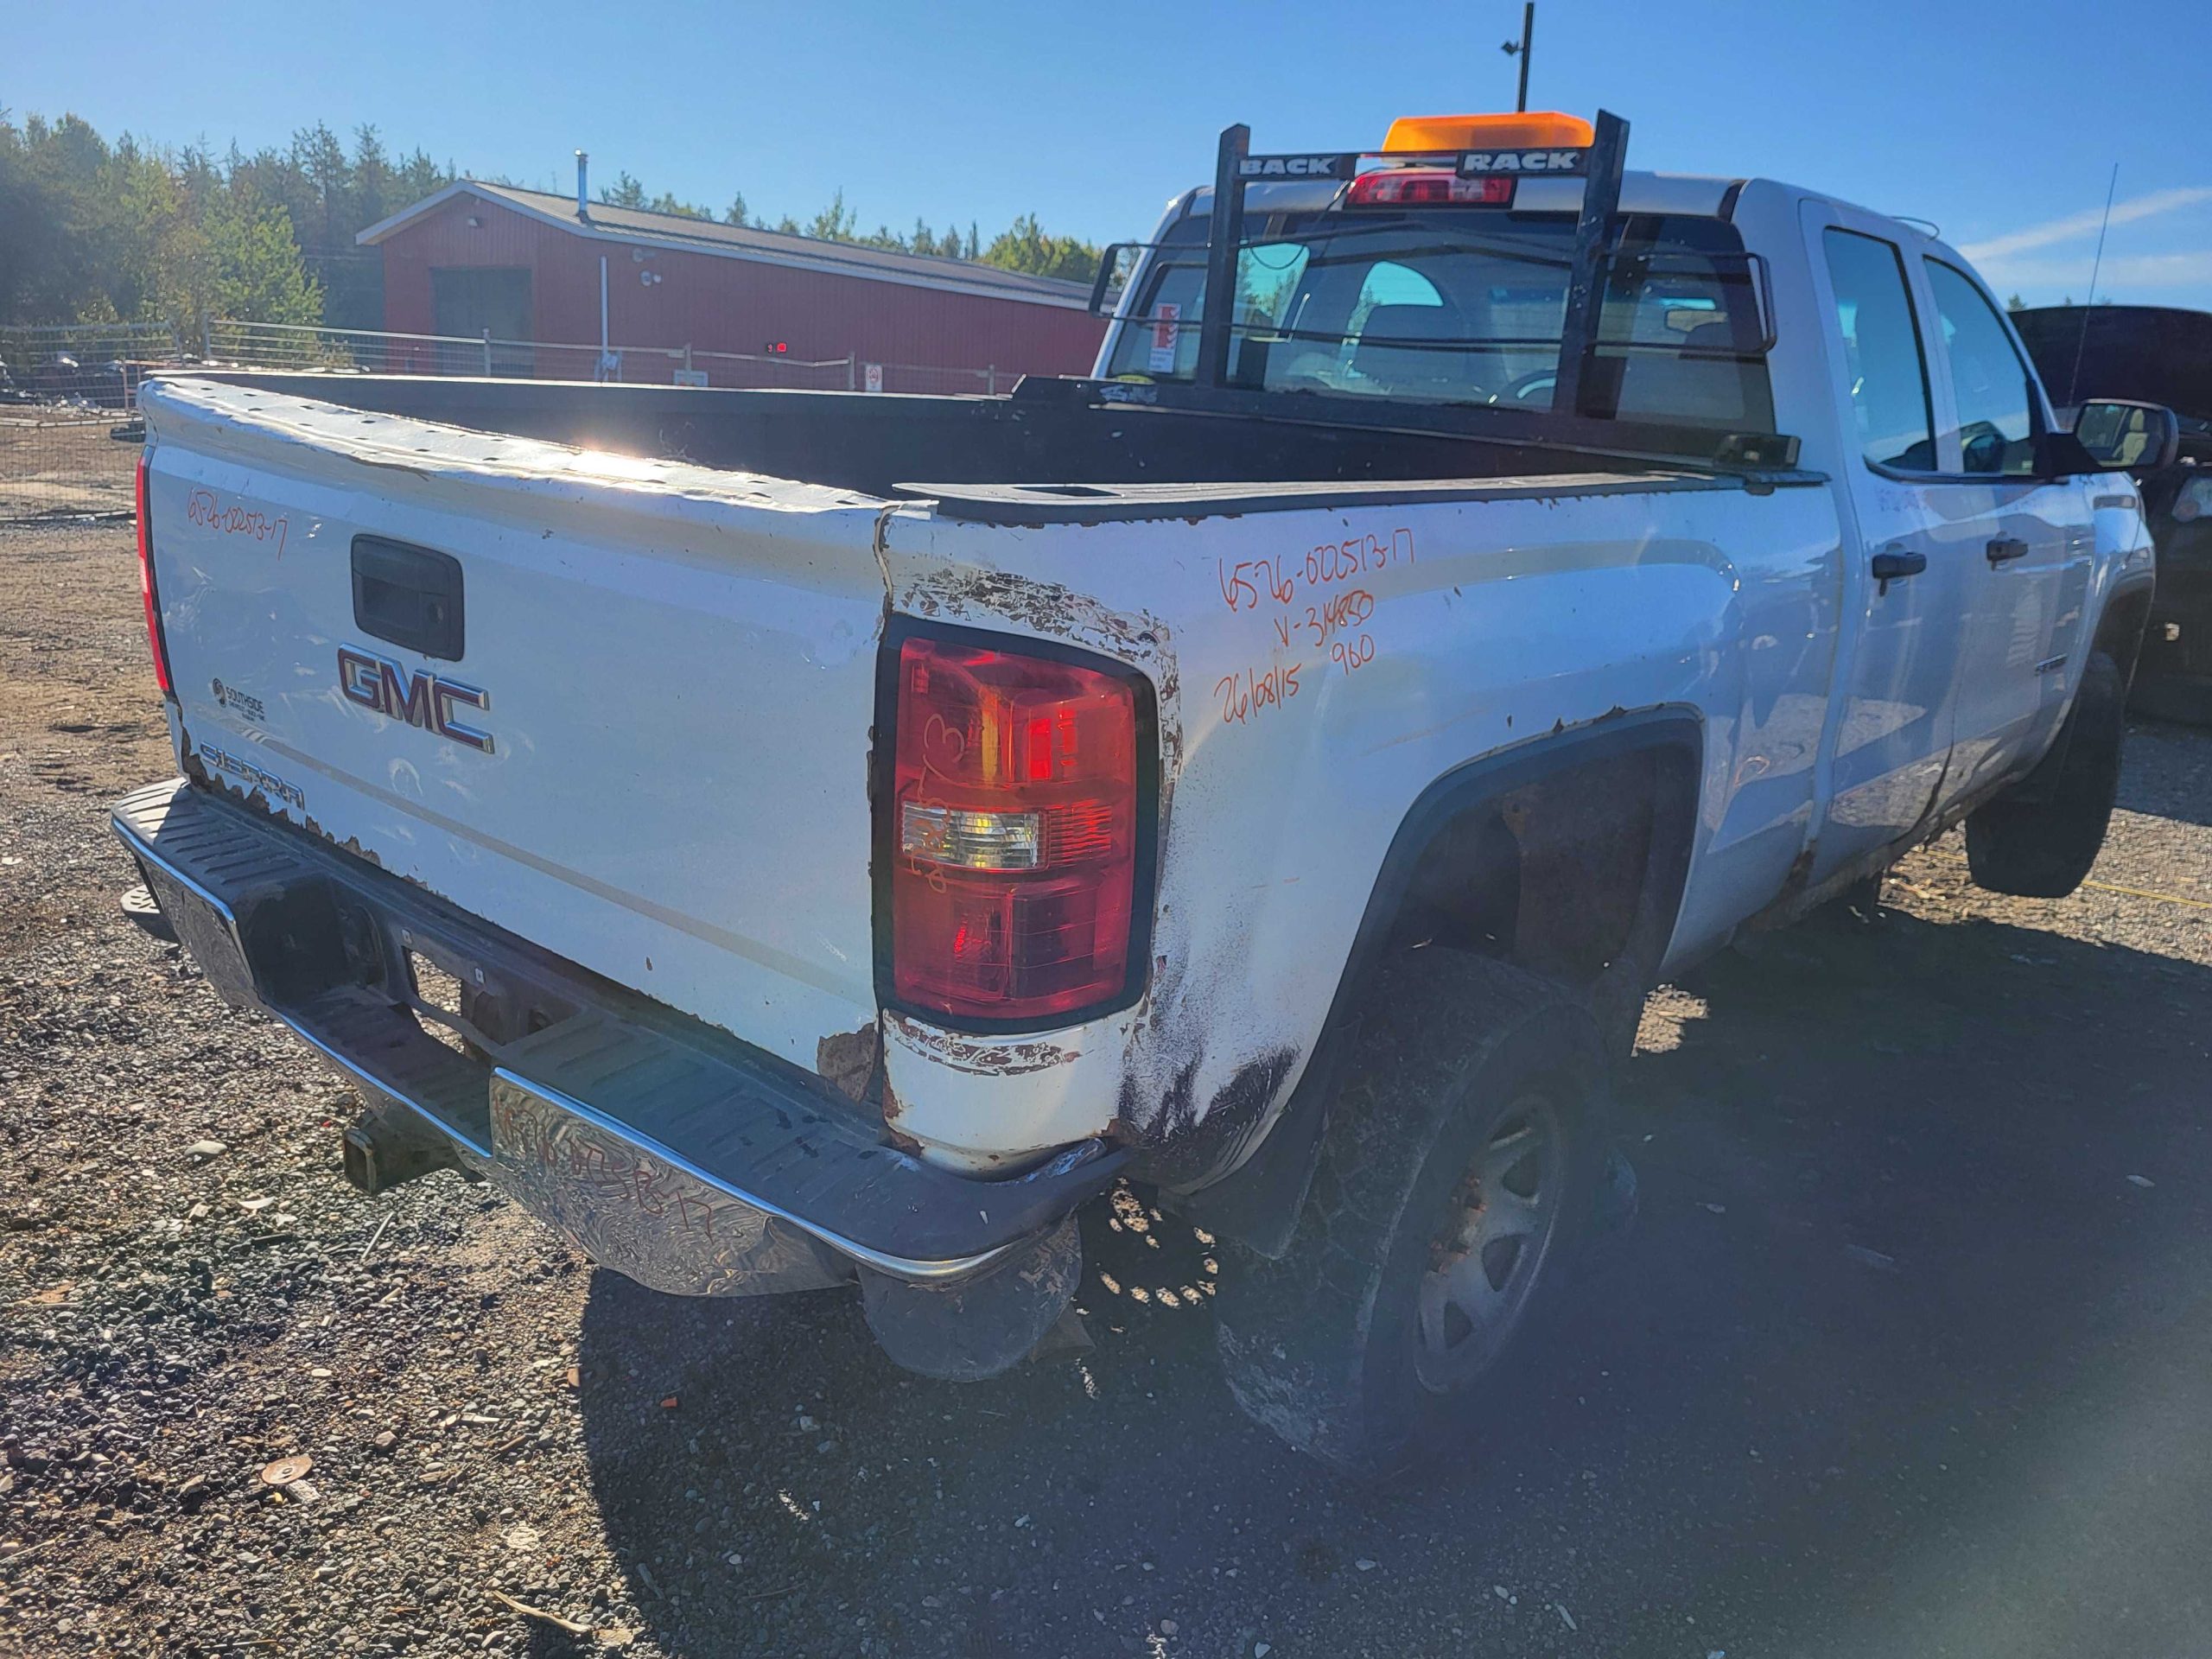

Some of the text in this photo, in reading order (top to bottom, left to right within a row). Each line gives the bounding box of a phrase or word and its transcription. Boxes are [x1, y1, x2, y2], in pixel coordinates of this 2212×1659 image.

[1239, 151, 1580, 175] BACK RACK
[337, 643, 495, 754] GMC
[200, 741, 305, 811] SIERRA
